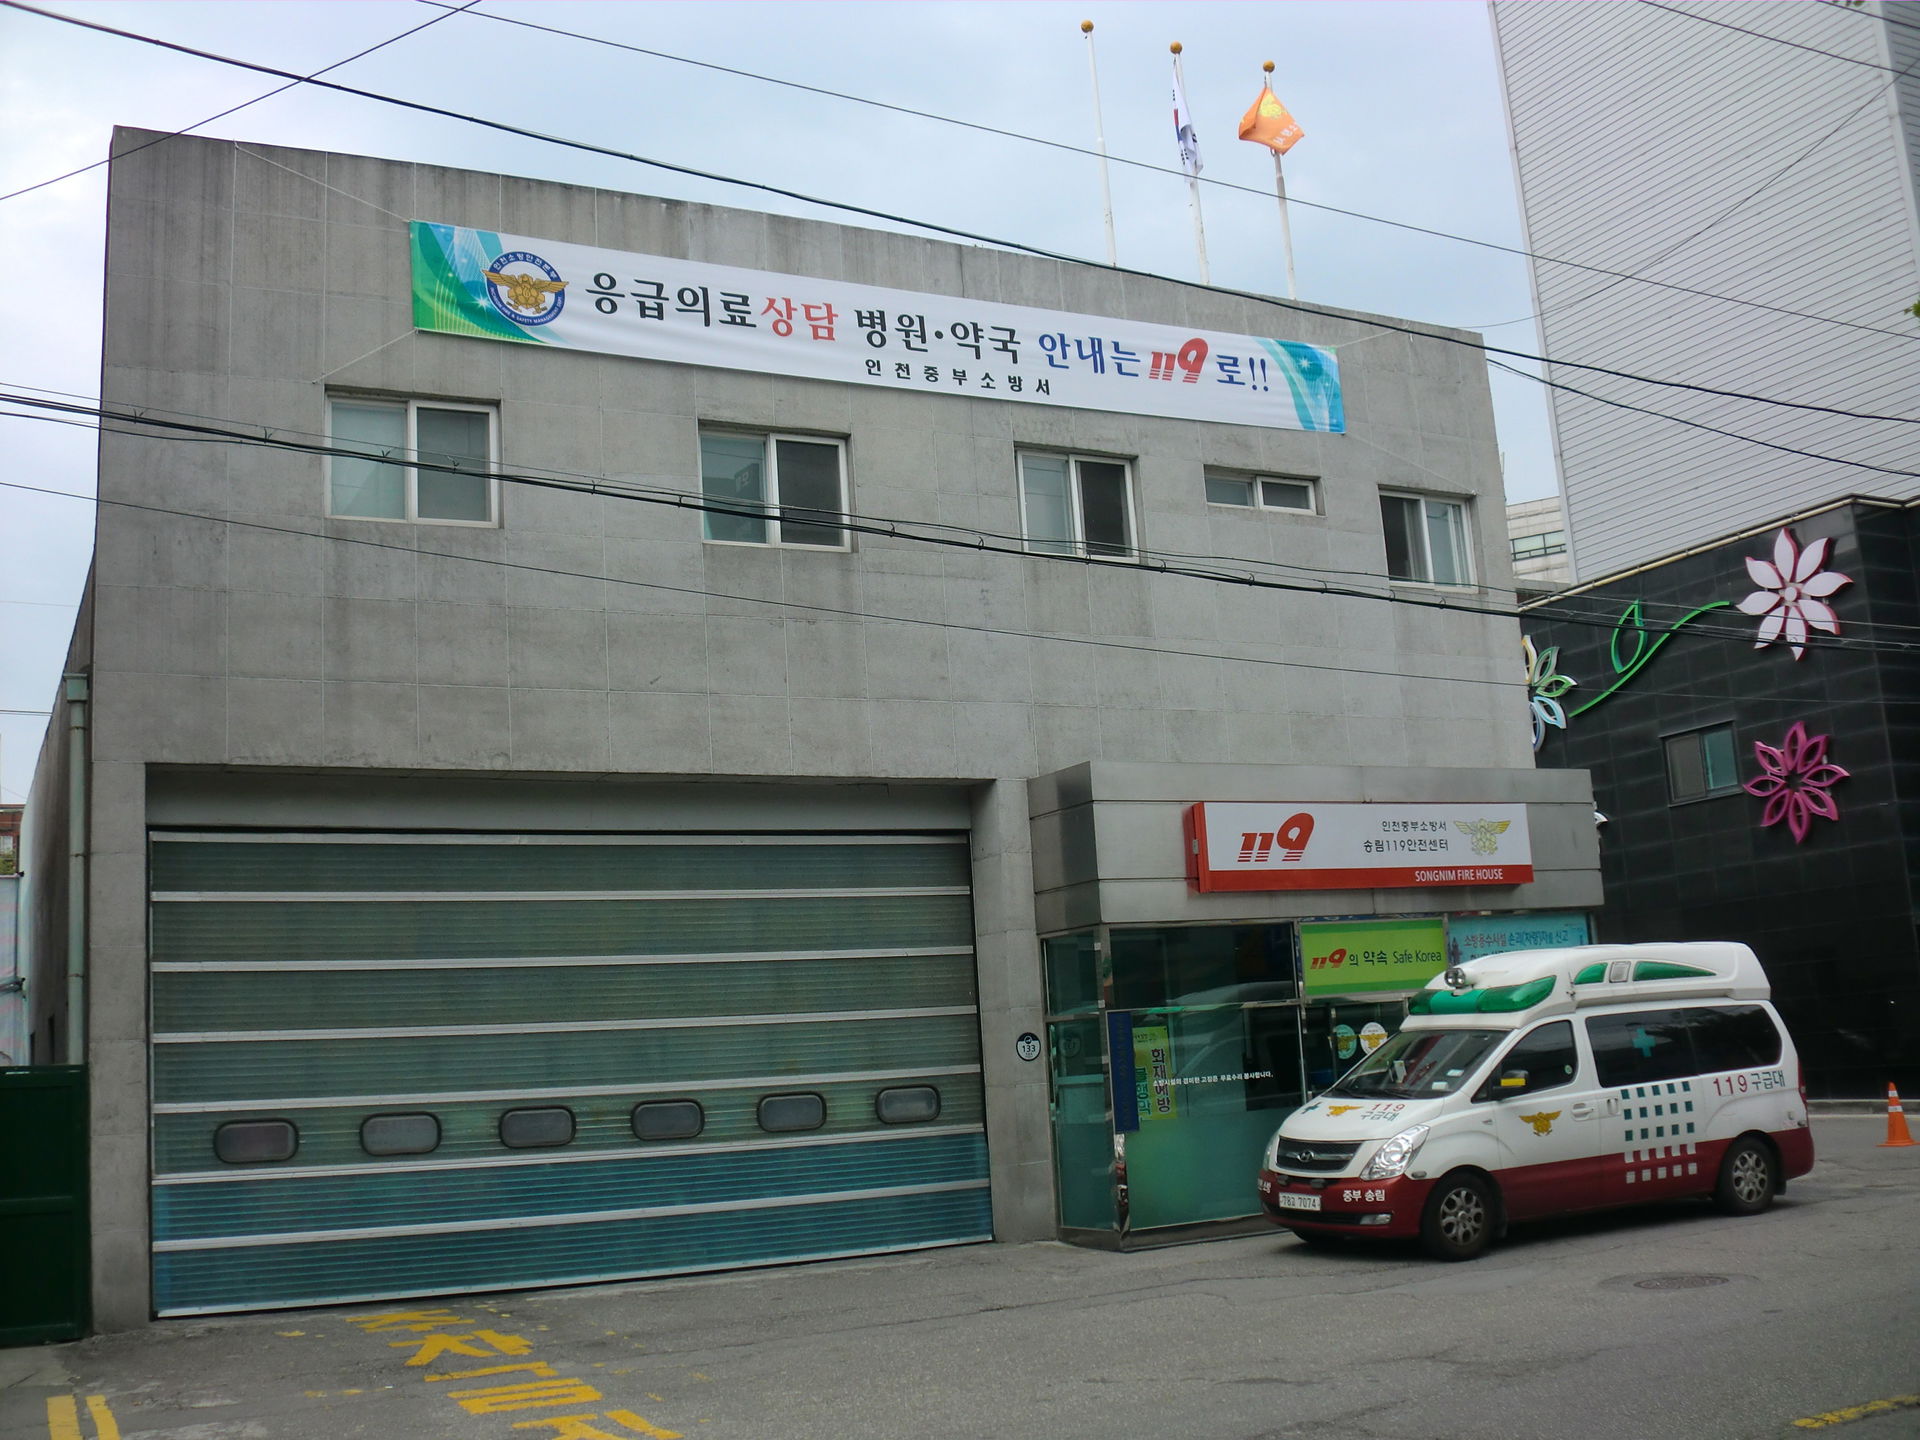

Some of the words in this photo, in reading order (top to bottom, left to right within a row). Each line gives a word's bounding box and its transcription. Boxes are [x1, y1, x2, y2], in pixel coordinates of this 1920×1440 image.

[1038, 332, 1141, 378] 안내는
[865, 358, 1050, 395] 인천중부소방서
[1382, 820, 1447, 832] 인천중부소방서
[1237, 812, 1315, 863] 119
[1363, 839, 1449, 853] 송림119안전센터
[1415, 869, 1456, 882] SONGNIM
[1458, 869, 1475, 881] FIRE
[1476, 868, 1504, 880] HOUSE
[1363, 950, 1388, 966] 약속
[1393, 951, 1413, 964] Safe
[1416, 950, 1442, 963] Korea
[1022, 1044, 1036, 1053] 133
[1372, 1103, 1406, 1112] 119
[1361, 1111, 1400, 1121] 구급대
[1343, 1190, 1361, 1202] 중부
[1365, 1189, 1385, 1202] 송림
